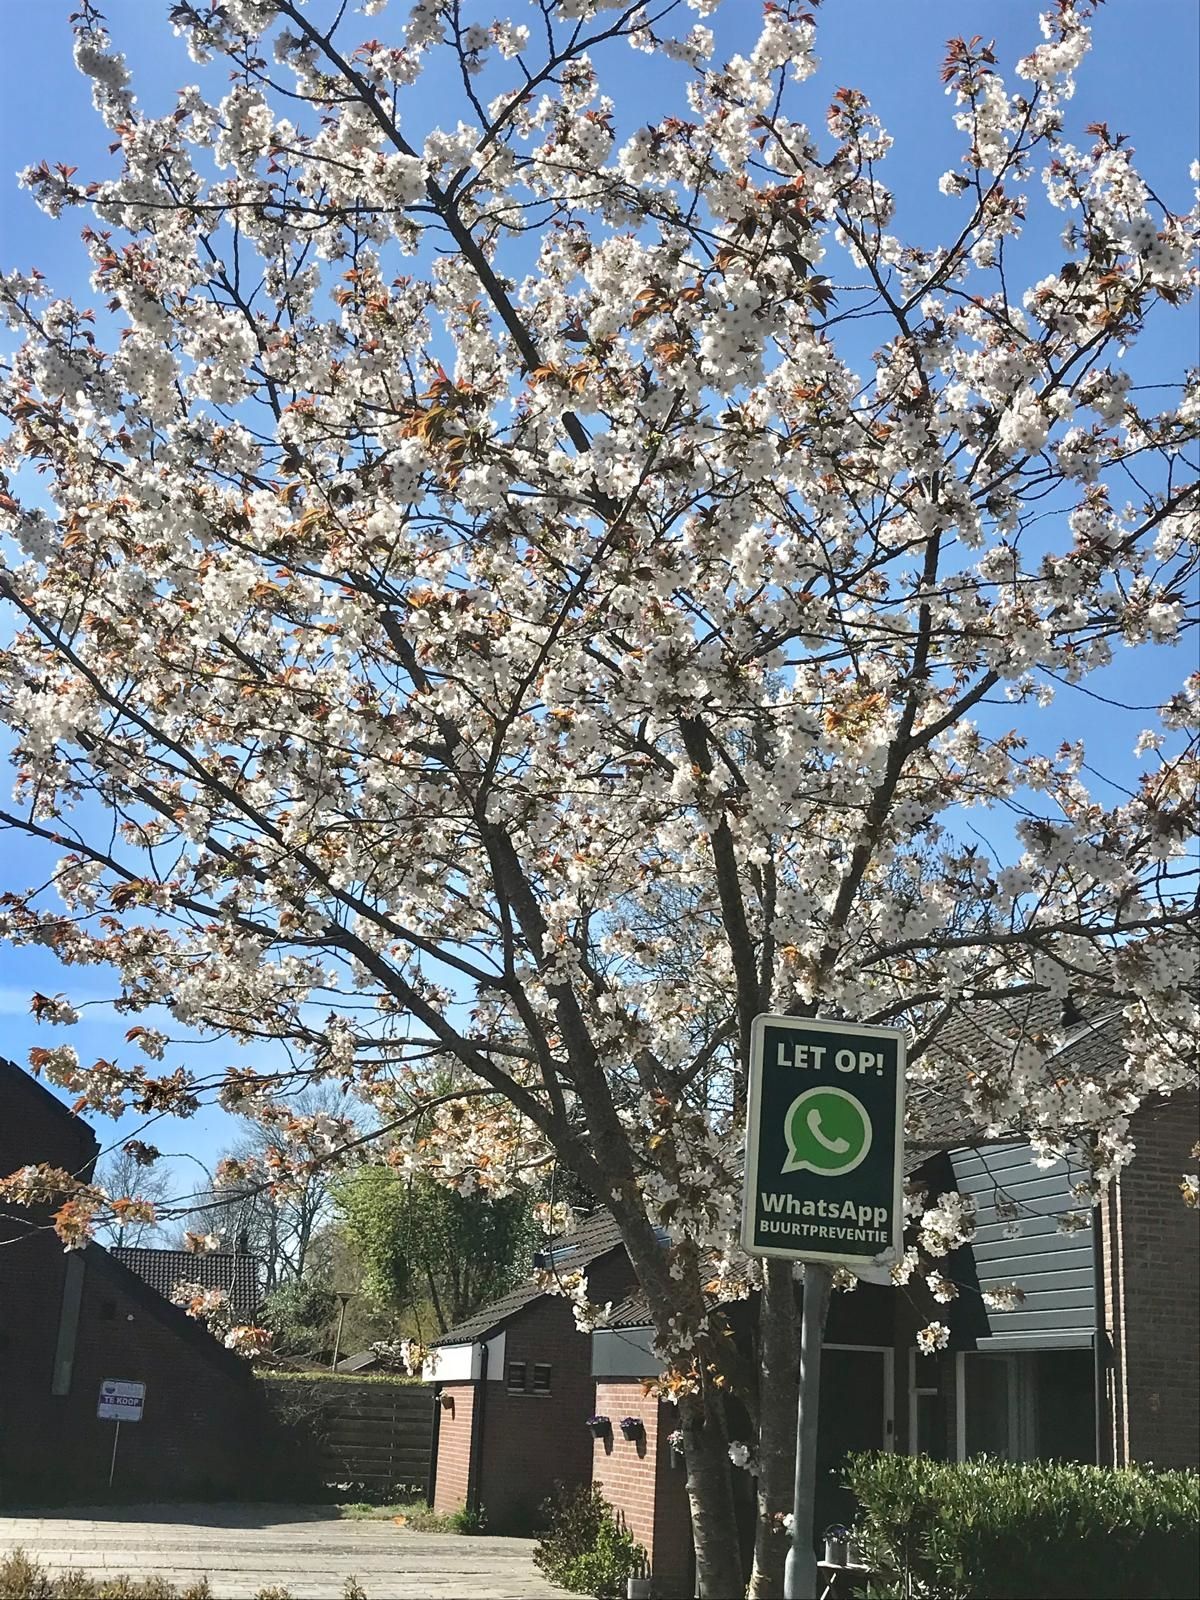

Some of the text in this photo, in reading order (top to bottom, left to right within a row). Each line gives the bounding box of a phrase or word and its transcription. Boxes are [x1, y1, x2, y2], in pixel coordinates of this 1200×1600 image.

[777, 1043, 884, 1076] LET OP!
[761, 1192, 888, 1228] WhatsApp
[760, 1220, 888, 1243] BUURTPREVENTIE
[104, 1396, 139, 1406] TE KOOP
